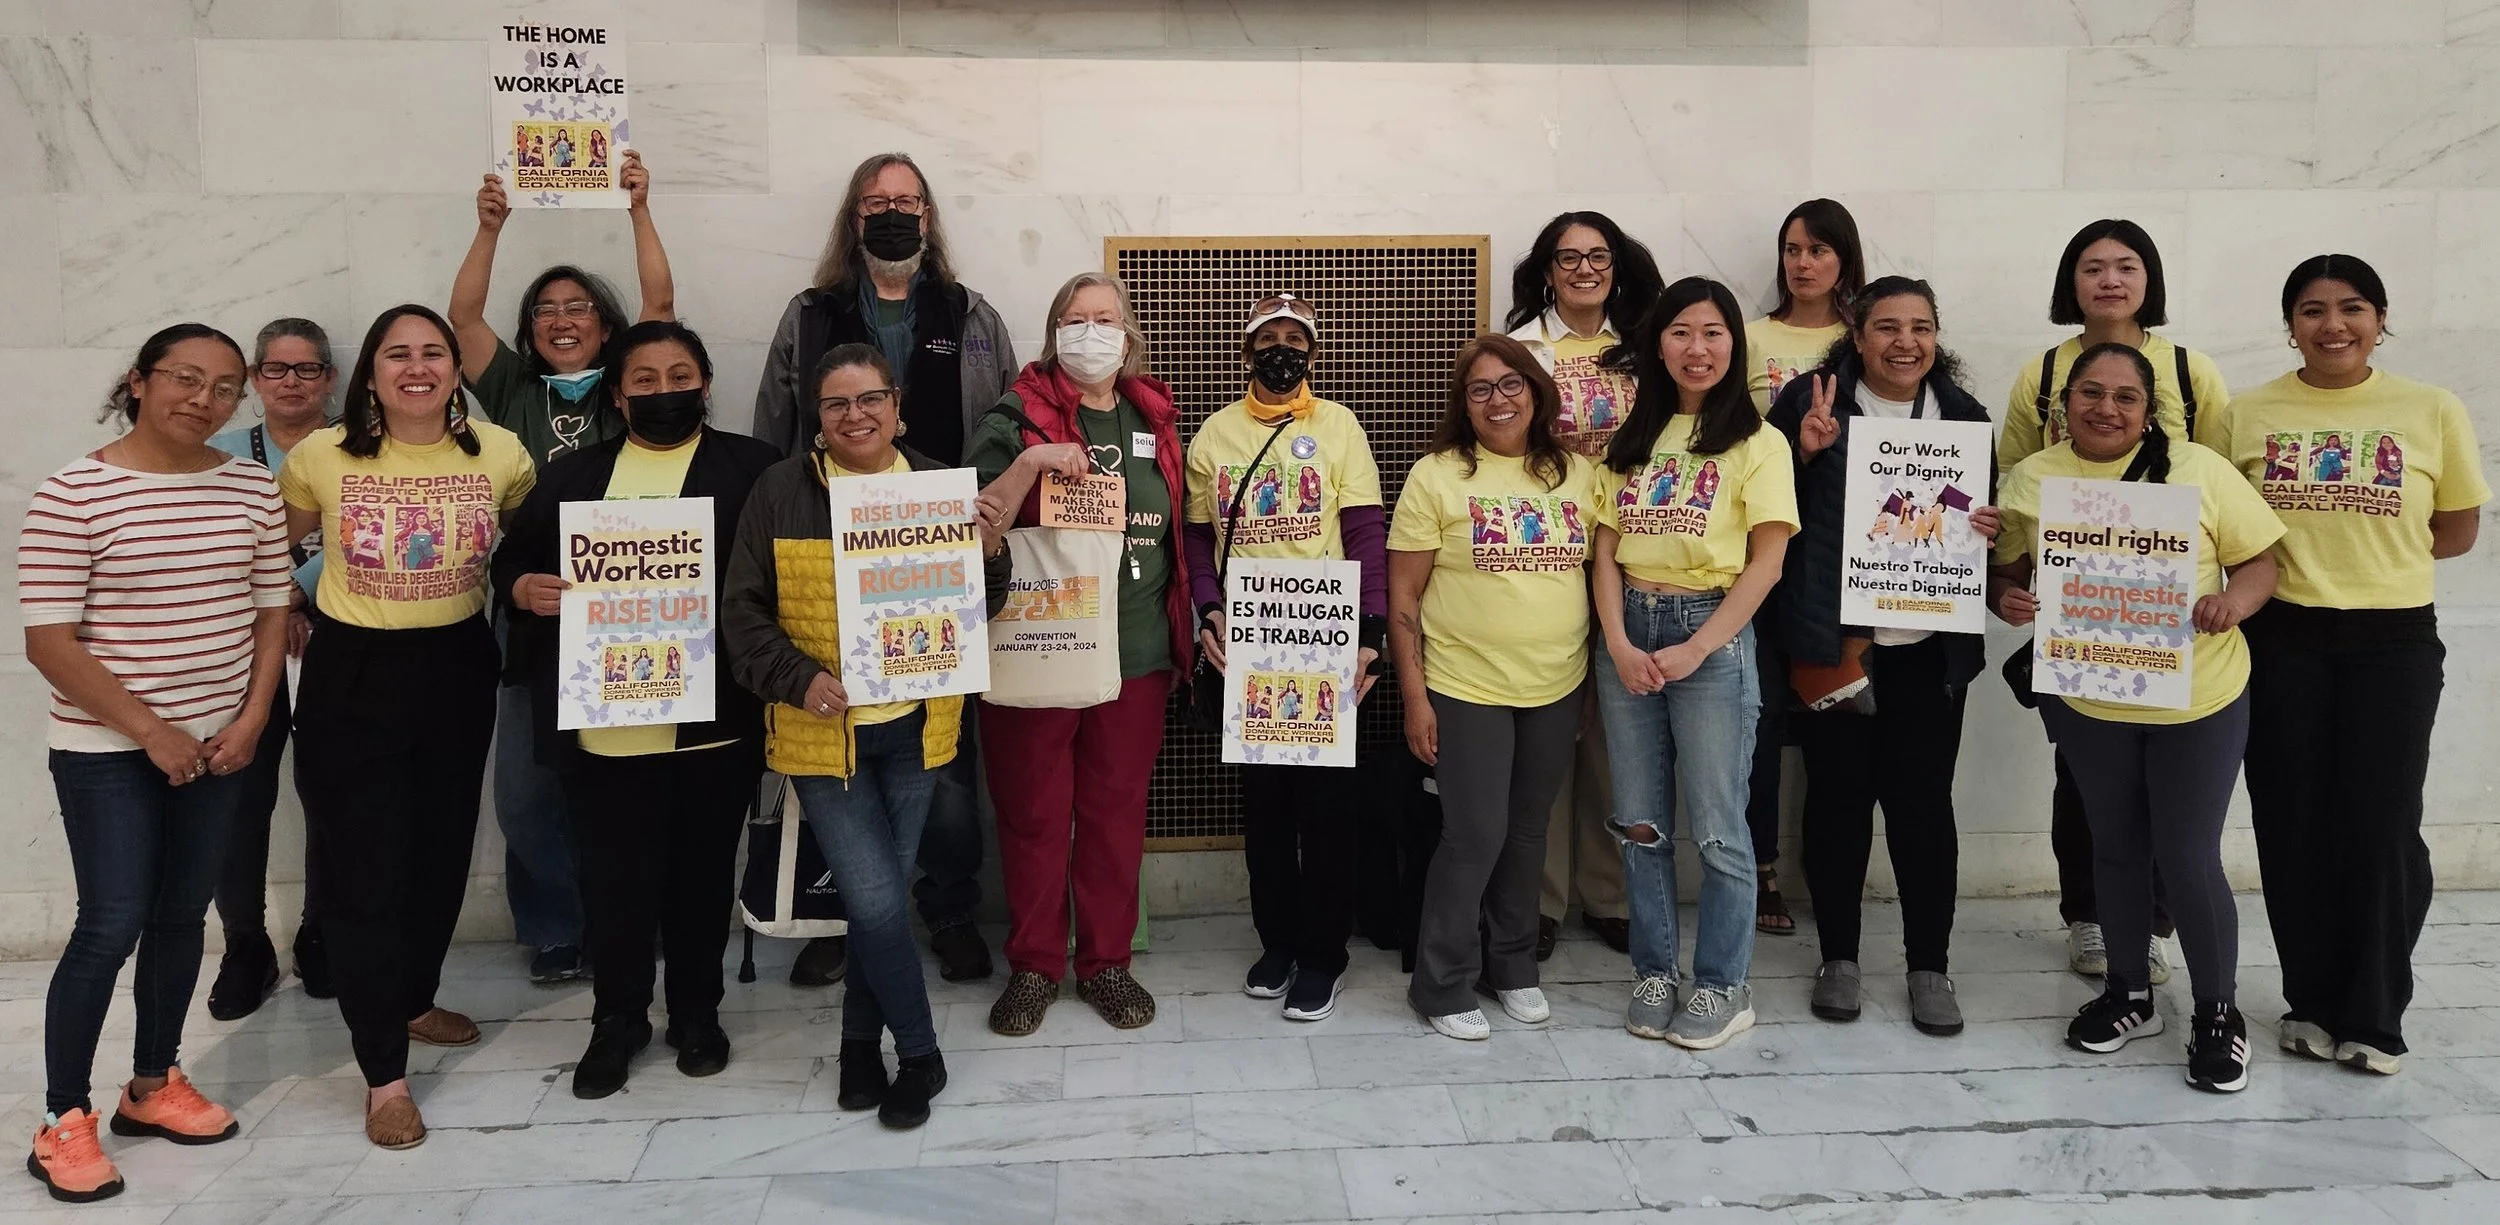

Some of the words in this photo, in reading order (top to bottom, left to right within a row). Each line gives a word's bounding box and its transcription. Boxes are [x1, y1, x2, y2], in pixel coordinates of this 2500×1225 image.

[504, 26, 540, 42] THE
[547, 27, 606, 44] HOME
[540, 52, 558, 68] IS
[564, 53, 579, 68] A
[494, 76, 624, 94] WORKPLACE
[1879, 441, 1910, 455] Our
[1915, 443, 1960, 458] Work
[1870, 462, 1901, 475] Our
[1906, 464, 1964, 482] Dignity
[342, 474, 491, 488] CALIFORNIA
[341, 486, 418, 496] DOMESTIC
[424, 485, 492, 495] WORKERS
[2262, 484, 2402, 500] CALIFORNIA
[341, 494, 492, 505] COALITION
[1050, 495, 1094, 506] MAKES
[1097, 499, 1120, 508] ALL
[2333, 495, 2402, 508] WORKERS
[851, 504, 892, 524] RISE
[898, 502, 922, 521] UP
[926, 500, 966, 518] FOR
[1065, 506, 1104, 516] WORK
[2267, 502, 2400, 518] COALITION
[1054, 514, 1114, 525] POSSIBLE
[843, 522, 976, 552] IMMIGRANT
[1232, 528, 1322, 545] OALITION
[1624, 525, 1704, 537] OALITION
[570, 531, 702, 558] Domestic
[2044, 527, 2111, 550] equal
[2118, 530, 2189, 556] rights
[1472, 547, 1584, 556] CALIFORNIA
[2044, 548, 2076, 568] for
[572, 556, 700, 583] Workers
[1850, 557, 1908, 572] Nuestro
[1914, 561, 1973, 579] Trabajo
[364, 570, 406, 584] FAMILIES
[410, 569, 452, 584] DESERVE
[860, 562, 965, 595] RIGHTS
[1008, 578, 1031, 591] eiu
[1062, 576, 1099, 588] THE
[384, 584, 419, 601] FAMILIAS
[422, 580, 456, 599] MERECEN
[1240, 576, 1264, 593] TU
[1270, 577, 1342, 595] HOGAR
[1848, 576, 1908, 592] Nuestra
[1912, 580, 1982, 596] Dignidad
[2062, 575, 2188, 608] domestic
[588, 598, 652, 625] RISE
[660, 596, 708, 622] UP!
[996, 608, 1021, 619] OF
[1025, 602, 1099, 621] CARE
[1232, 601, 1254, 618] ES
[1260, 602, 1282, 619] MI
[1288, 604, 1354, 621] LUGAR
[2061, 602, 2180, 629] workers
[1015, 632, 1076, 640] CONVENTION
[1231, 627, 1254, 644] DE
[1260, 628, 1349, 646] TRABAJO
[994, 644, 1038, 652] JANUARY
[1041, 643, 1070, 652] 23-24,
[1074, 642, 1096, 650] 2024
[2093, 645, 2176, 659] CALIFORNIA
[884, 653, 956, 665] CALIFORNIA
[2092, 656, 2176, 670] COALITION
[885, 664, 957, 676] COALITION
[604, 681, 680, 690] CALIFORNIA
[604, 692, 680, 700] COALITION
[1246, 721, 1332, 730] CALIFORNIA
[1245, 735, 1334, 743] COALITION
